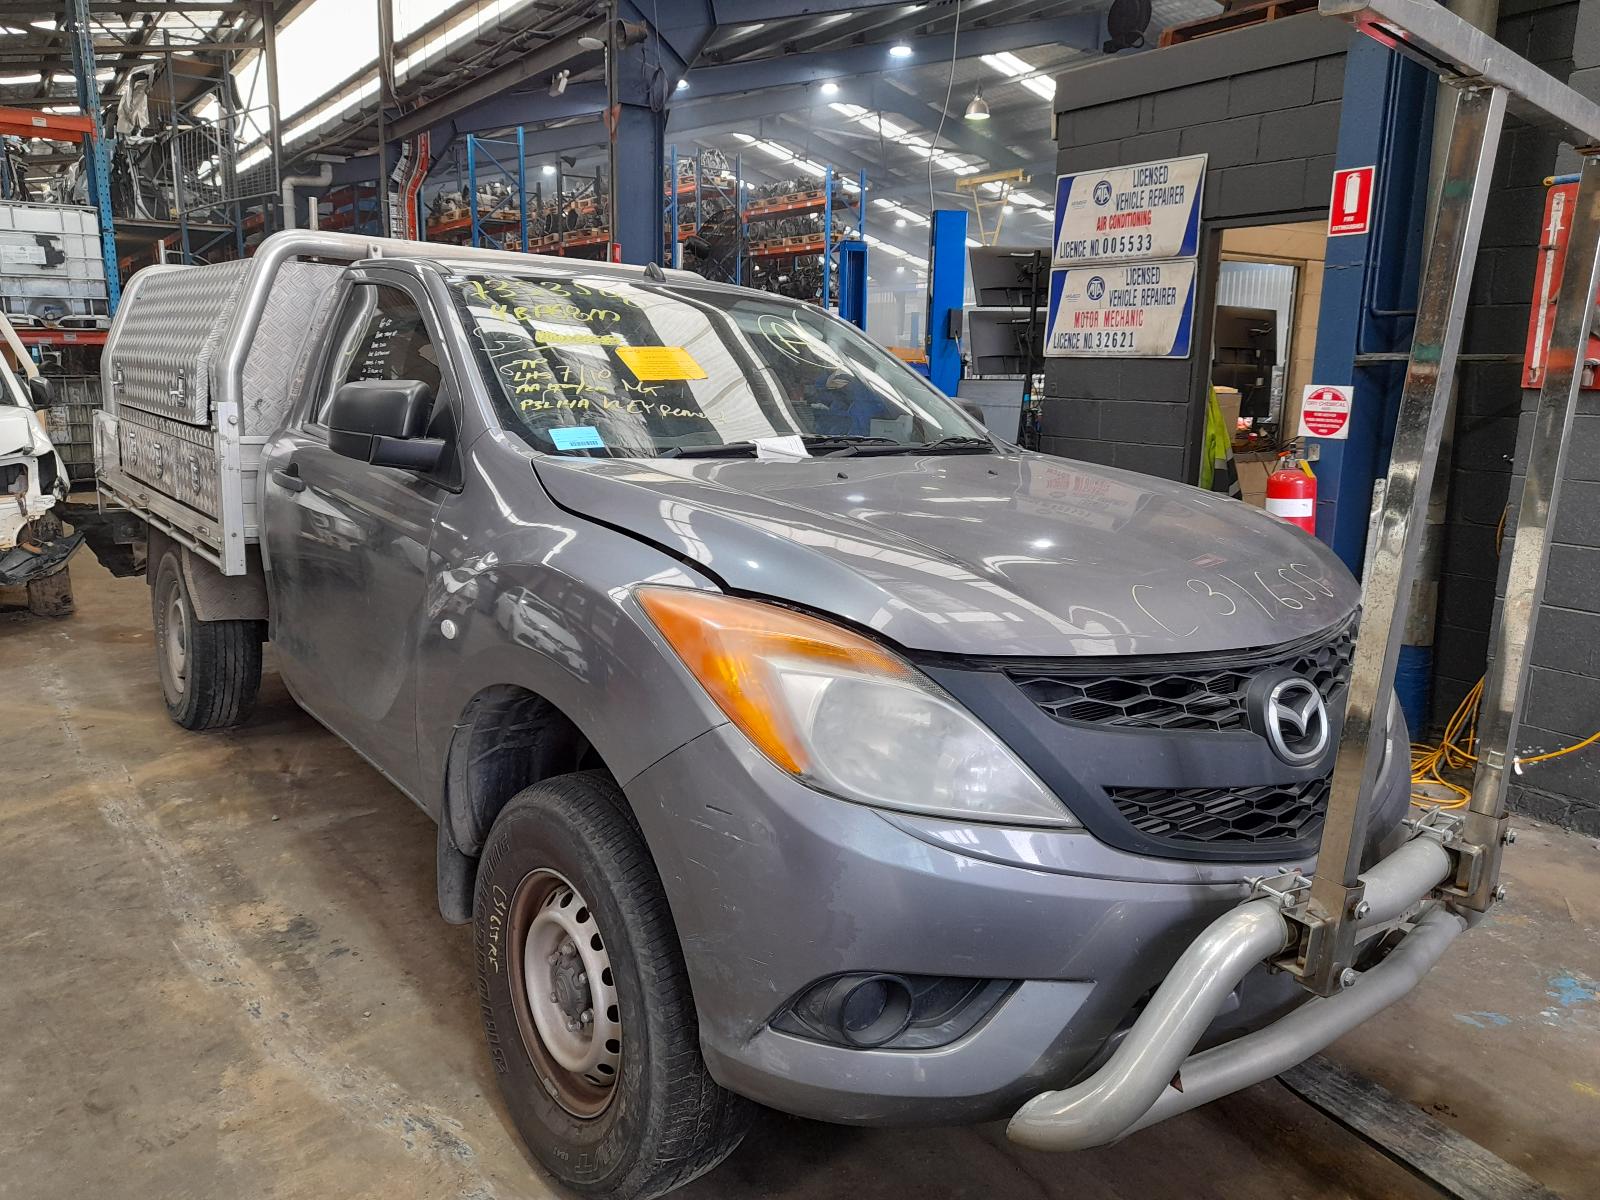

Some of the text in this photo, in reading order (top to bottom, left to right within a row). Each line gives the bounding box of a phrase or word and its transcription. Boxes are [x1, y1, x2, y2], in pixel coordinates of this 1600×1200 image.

[1133, 165, 1168, 187] LICENSED
[1116, 185, 1185, 211] VEHICLE REPAIRER
[1096, 210, 1152, 231] AIR CONDITIONING
[1060, 240, 1087, 259] LICENCE
[1102, 234, 1152, 254] 005533
[1126, 266, 1160, 286] LICENSED
[1109, 287, 1176, 307] VEHICLE REPAIRER
[1074, 309, 1144, 328] MOTOR MECHANIC
[1053, 333, 1081, 349] LICENCE
[1096, 331, 1134, 348] 32621
